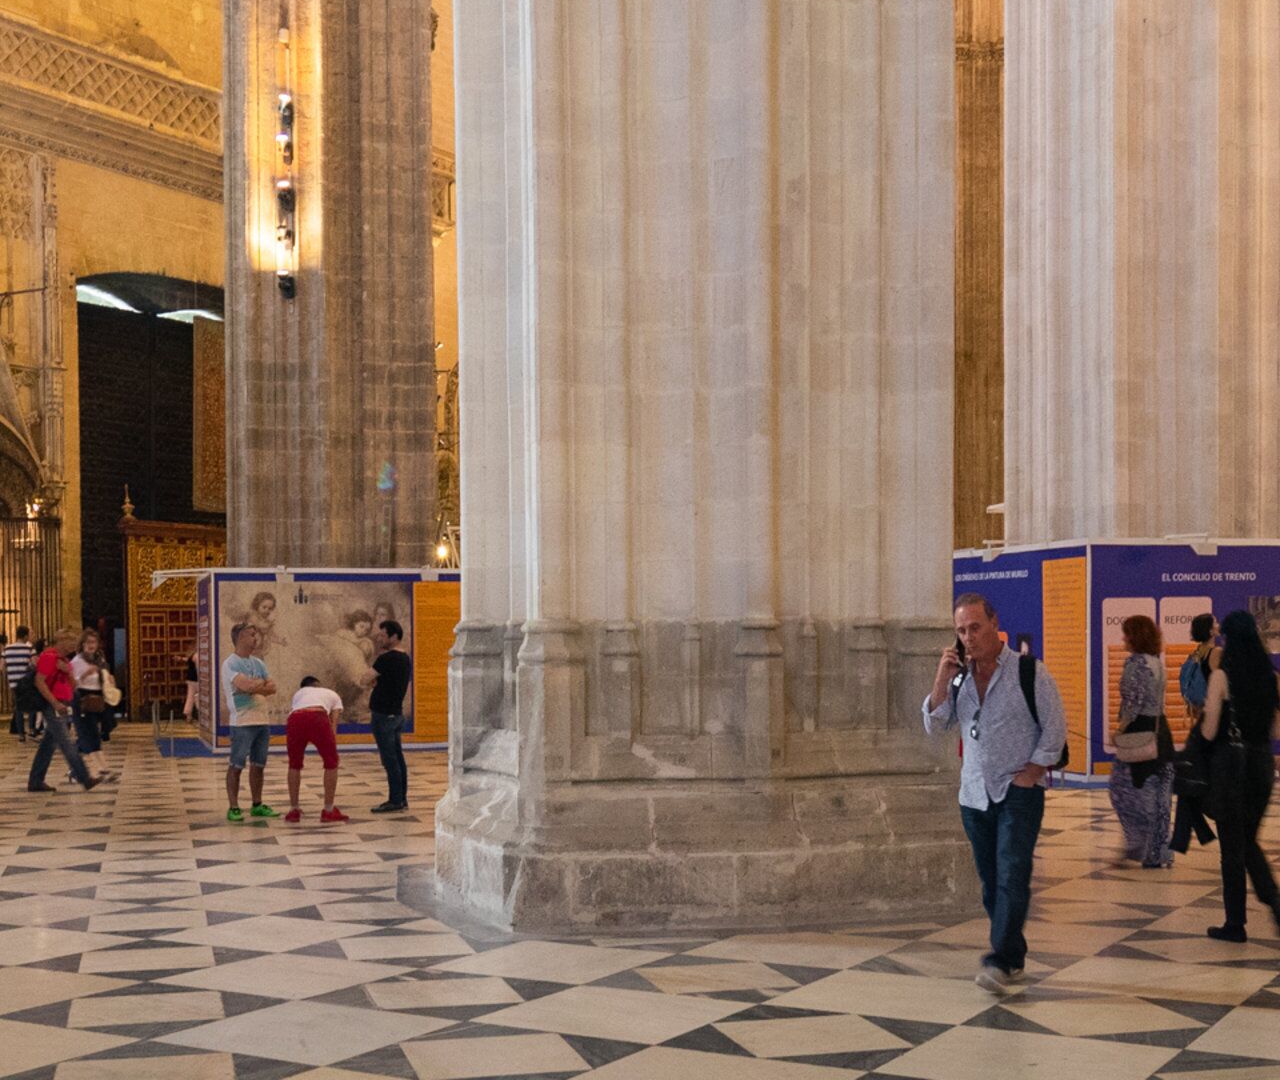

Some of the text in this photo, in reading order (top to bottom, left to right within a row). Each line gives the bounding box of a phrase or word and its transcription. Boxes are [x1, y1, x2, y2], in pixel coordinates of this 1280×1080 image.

[1161, 572, 1257, 582] EL CONCILIO DE TRENTO
